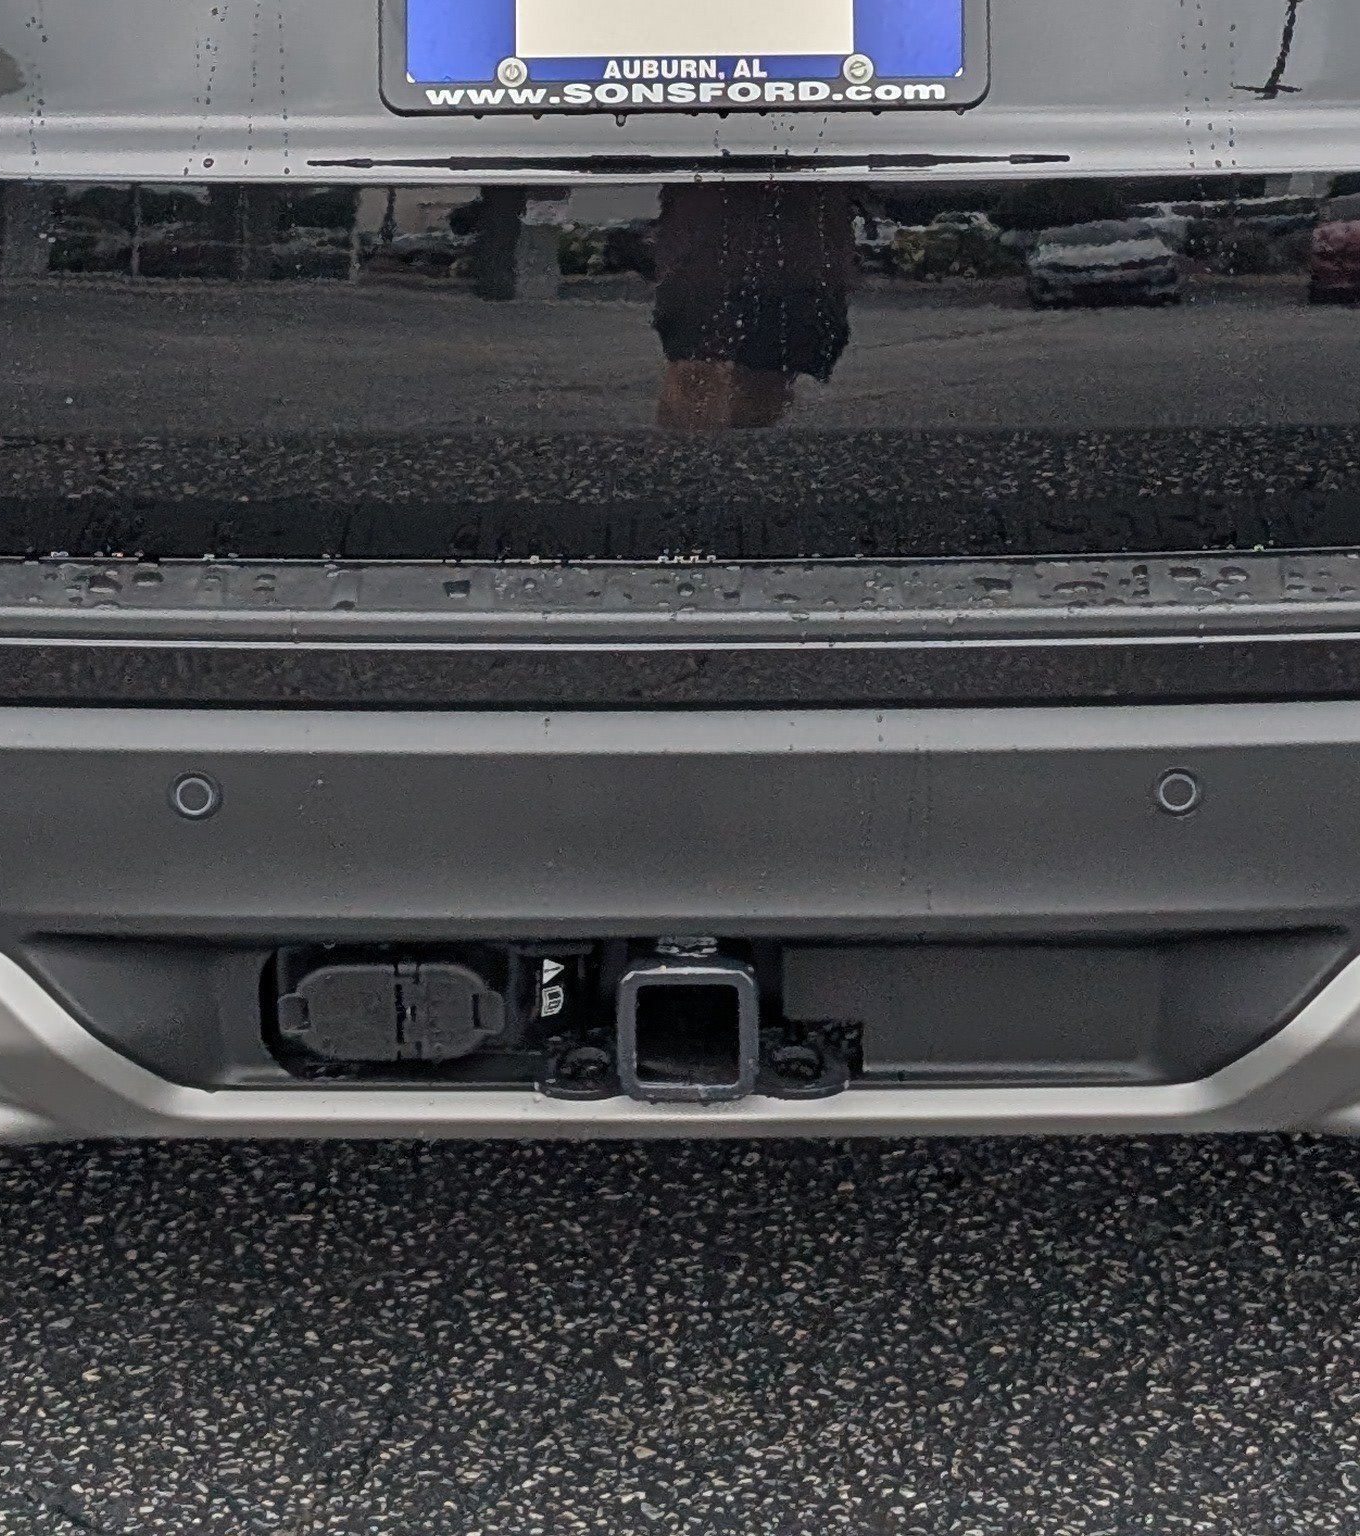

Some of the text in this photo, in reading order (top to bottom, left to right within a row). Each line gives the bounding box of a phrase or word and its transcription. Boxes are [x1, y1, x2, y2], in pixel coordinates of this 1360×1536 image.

[603, 58, 768, 80] AUBURN, AL
[425, 80, 947, 106] www.SONSFORD.com
